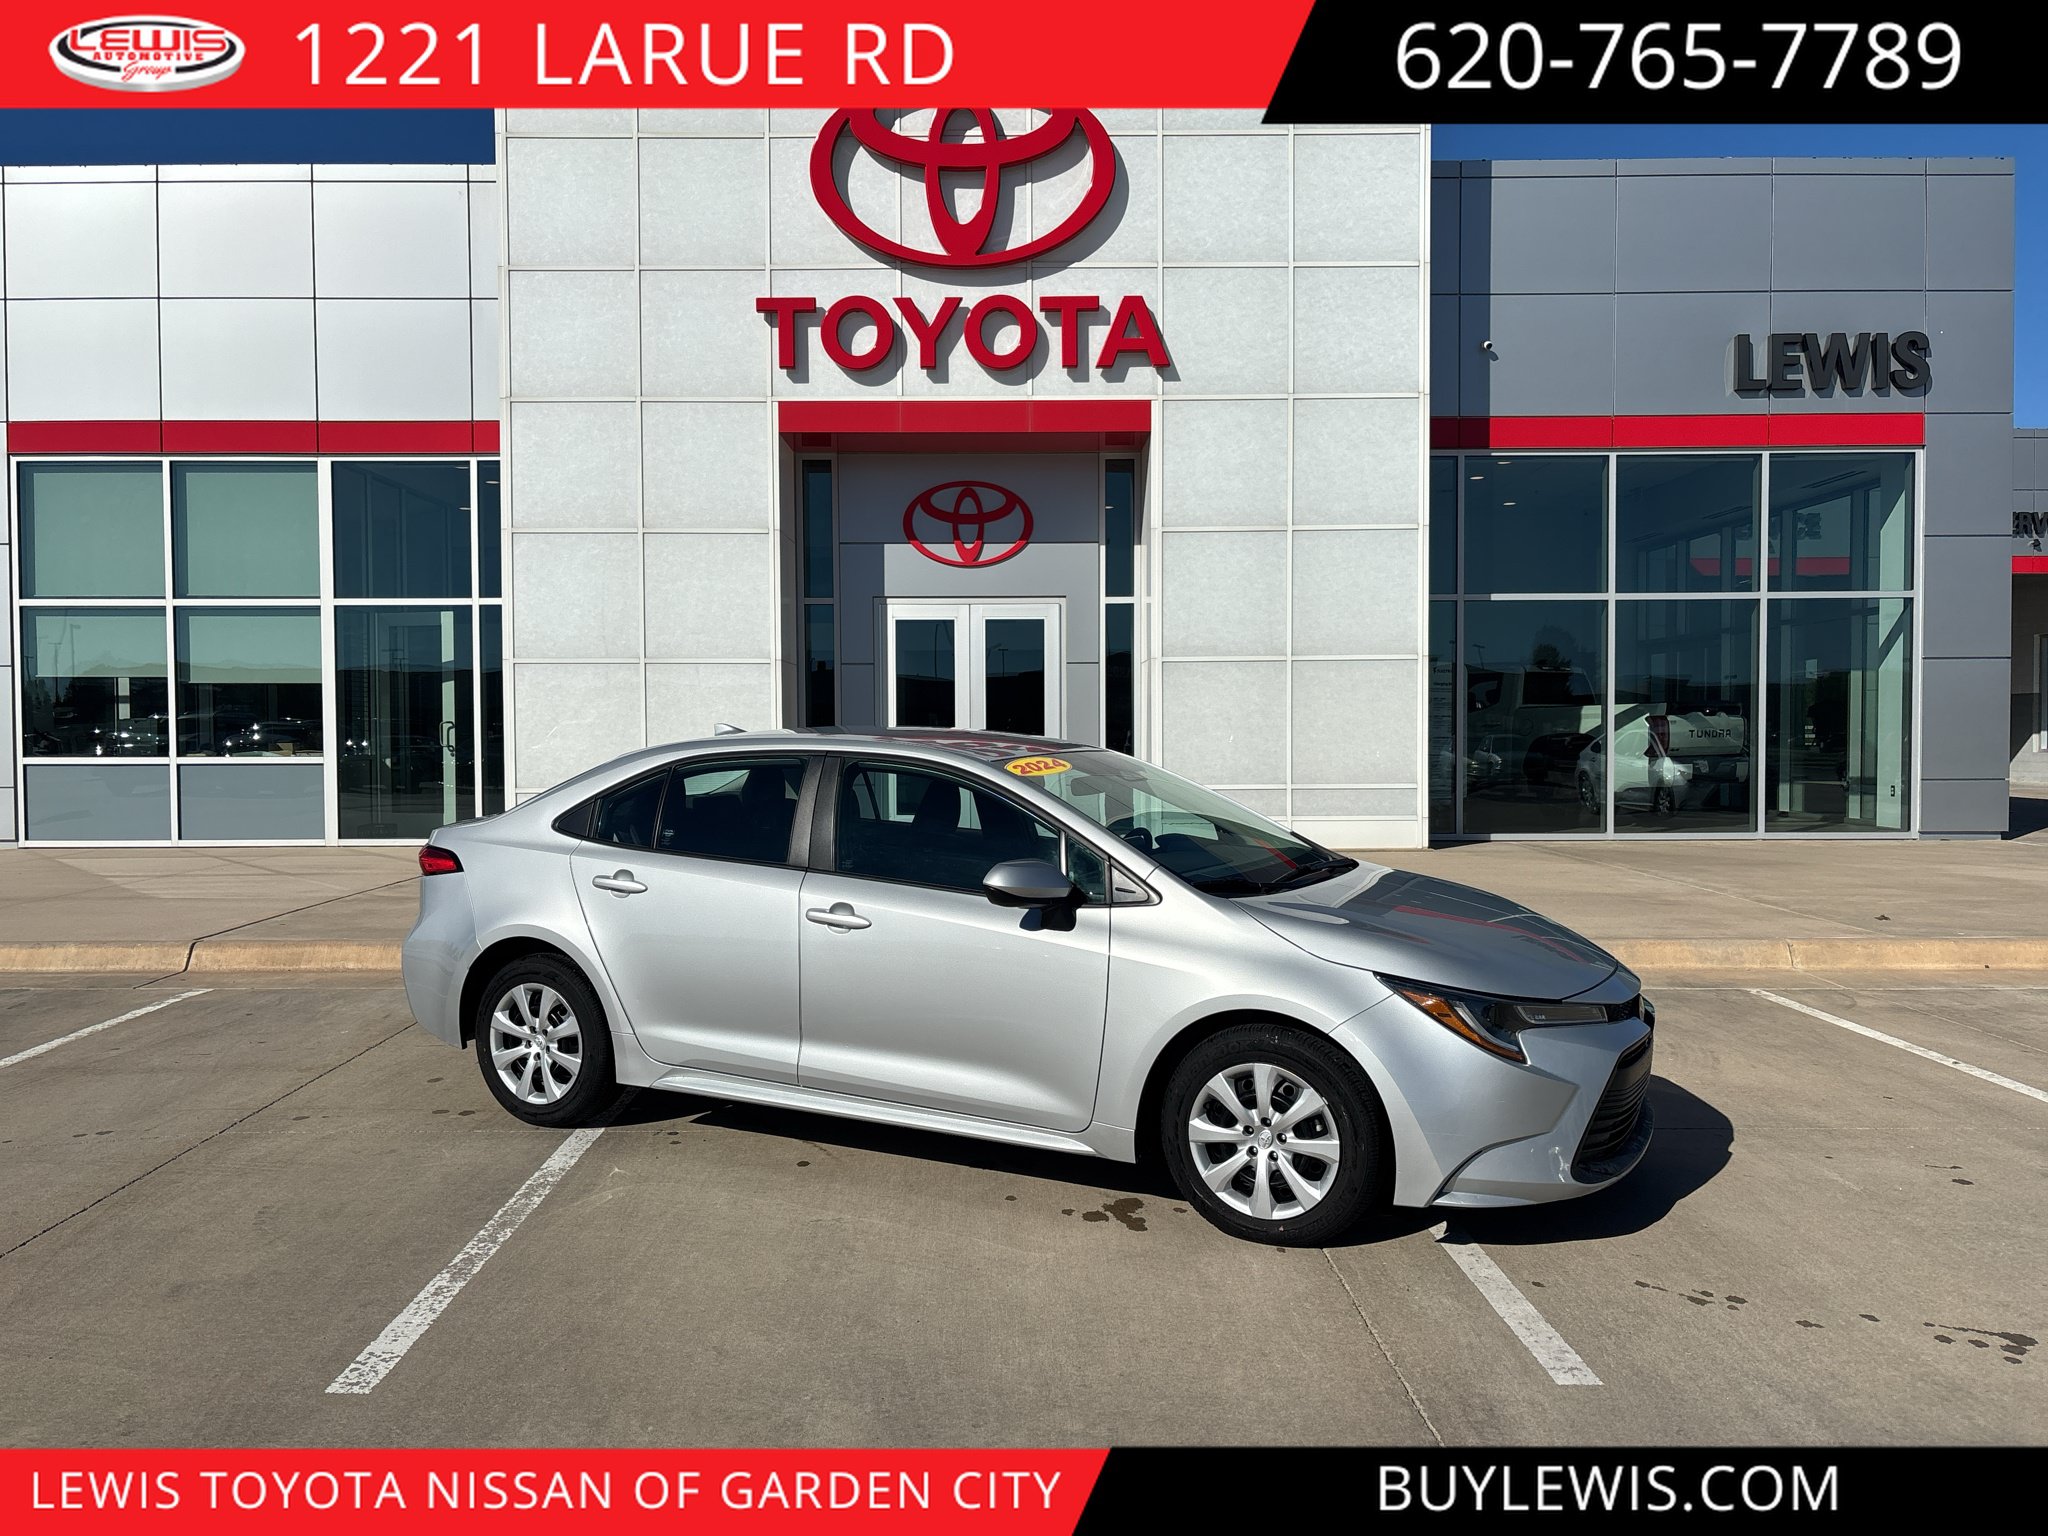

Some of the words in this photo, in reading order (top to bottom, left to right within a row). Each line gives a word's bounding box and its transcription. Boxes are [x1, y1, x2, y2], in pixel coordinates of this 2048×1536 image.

[756, 294, 1172, 371] TOYOTA
[1732, 330, 1932, 392] LEWIS
[1688, 728, 1732, 739] TUNDRA
[1012, 757, 1068, 775] 2024
